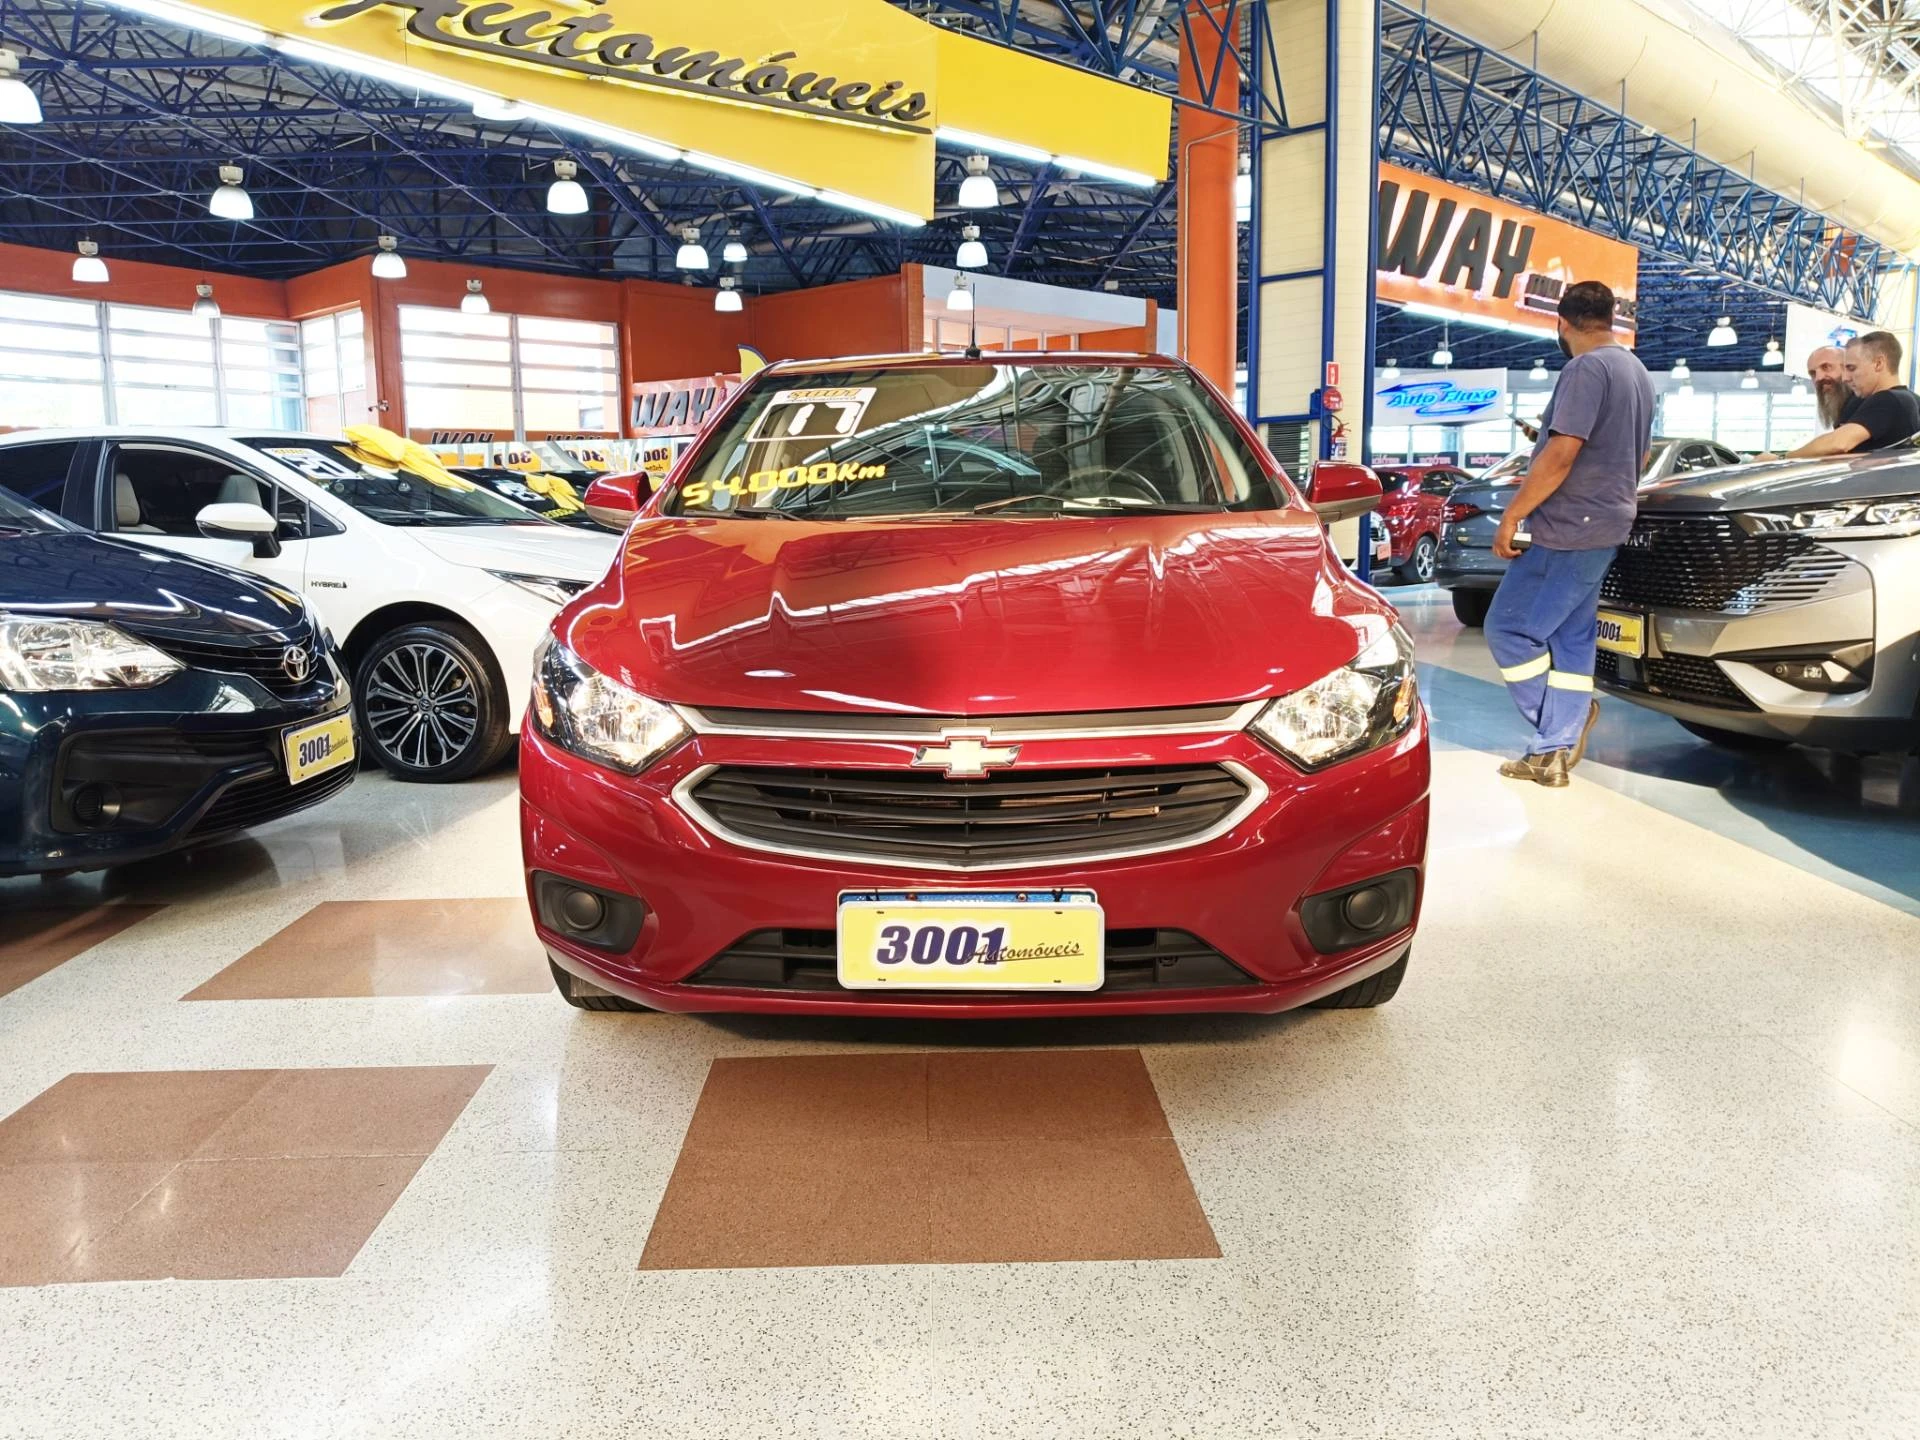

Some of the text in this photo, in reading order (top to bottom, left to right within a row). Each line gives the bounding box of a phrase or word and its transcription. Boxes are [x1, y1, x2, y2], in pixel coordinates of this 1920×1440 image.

[1378, 180, 1536, 298] WAY
[632, 387, 716, 427] WAY
[1386, 389, 1498, 407] Auto Fluxo
[787, 402, 862, 436] 17
[1597, 620, 1621, 641] 3001
[299, 733, 330, 767] 3001
[876, 925, 1085, 966] 3001 Automóveis
